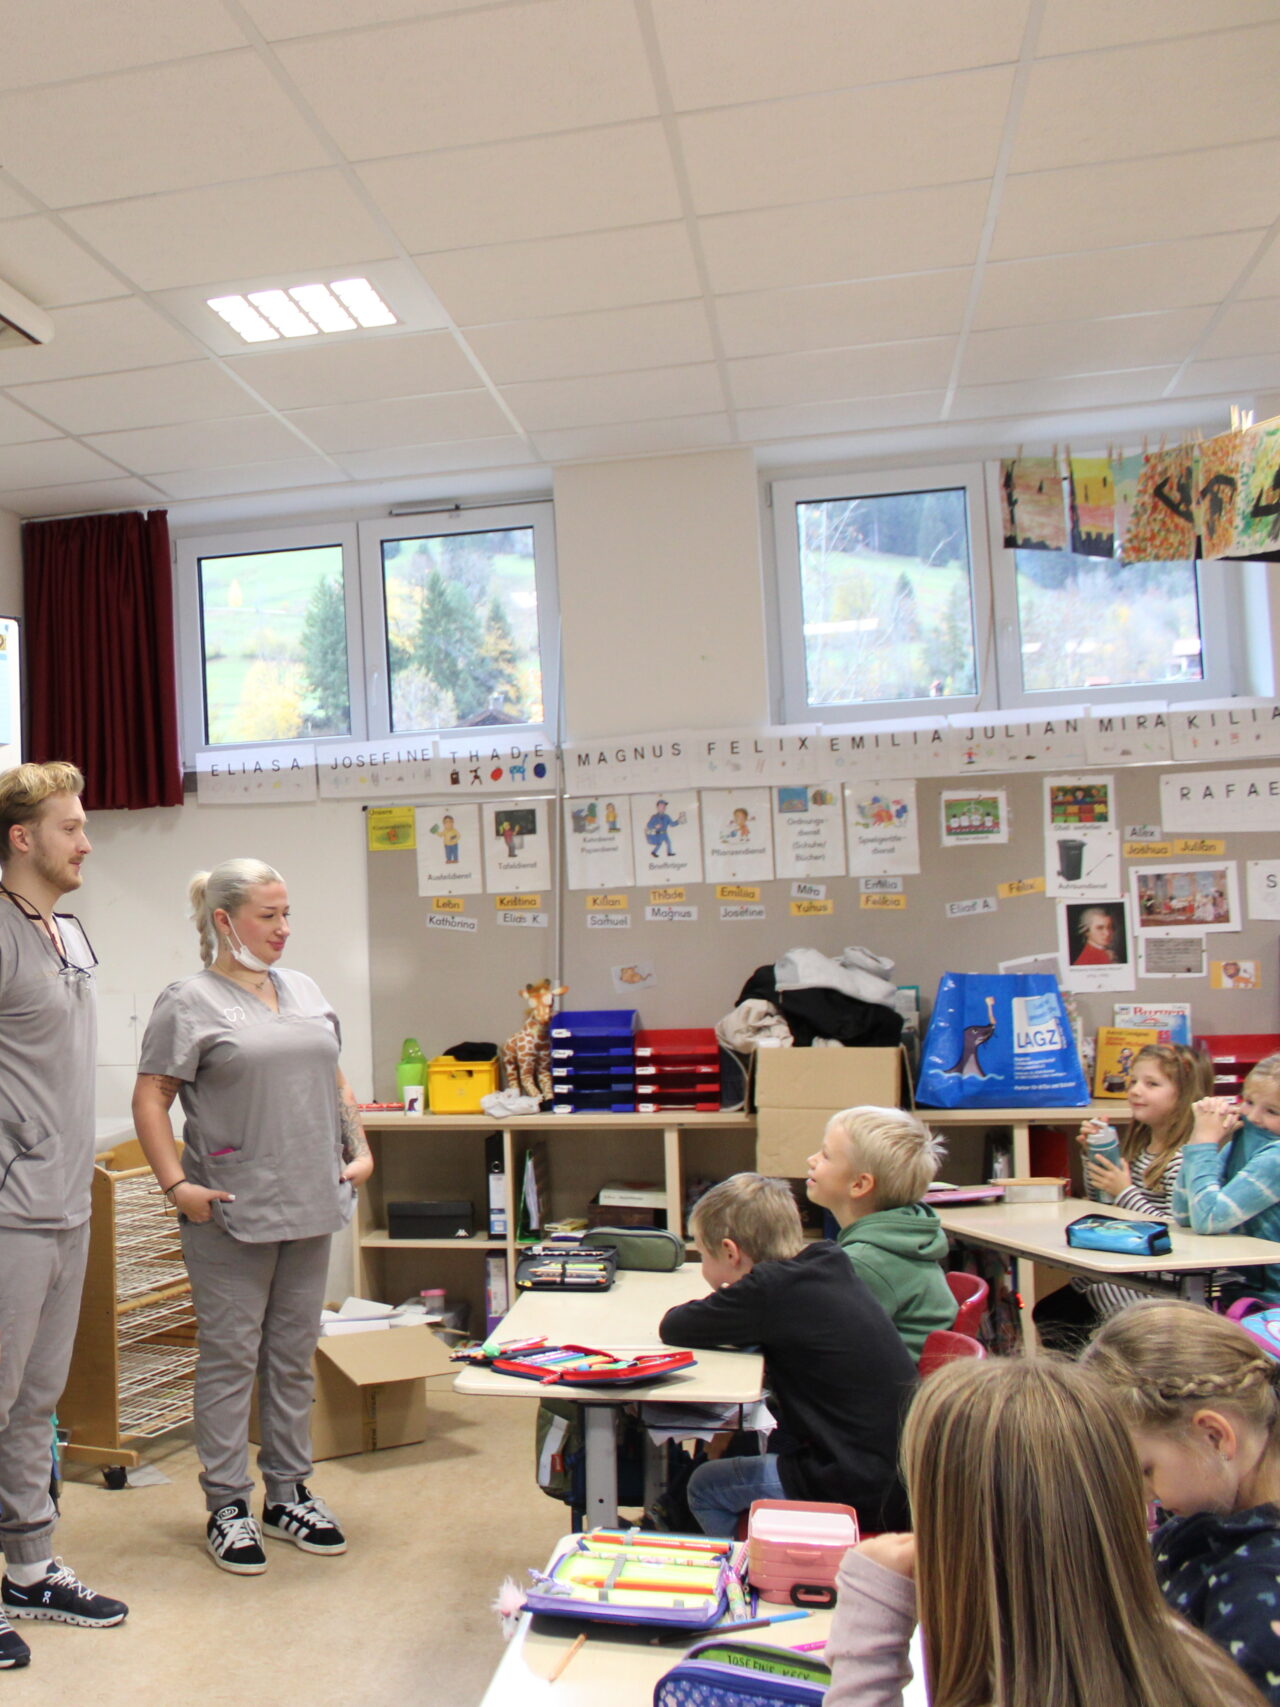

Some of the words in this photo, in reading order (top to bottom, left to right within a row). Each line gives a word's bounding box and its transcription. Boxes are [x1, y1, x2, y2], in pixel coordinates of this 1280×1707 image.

[965, 718, 1078, 741] JULIAN
[1099, 713, 1167, 733] MIRA
[707, 736, 809, 755] FELIX
[829, 728, 943, 753] EMILIA
[329, 747, 432, 770] JOSEFINE
[577, 742, 682, 768] MAGNUS
[211, 759, 281, 777] ELIAS
[1179, 781, 1280, 801] RAFAE
[1008, 882, 1036, 894] Felix
[436, 898, 460, 909] Leon
[503, 912, 527, 924] Elias
[590, 916, 628, 926] Samuel
[652, 907, 691, 920] Magnus
[722, 908, 764, 918] Josefine
[429, 915, 476, 930] Katharina
[1017, 1029, 1058, 1048] LAGZ
